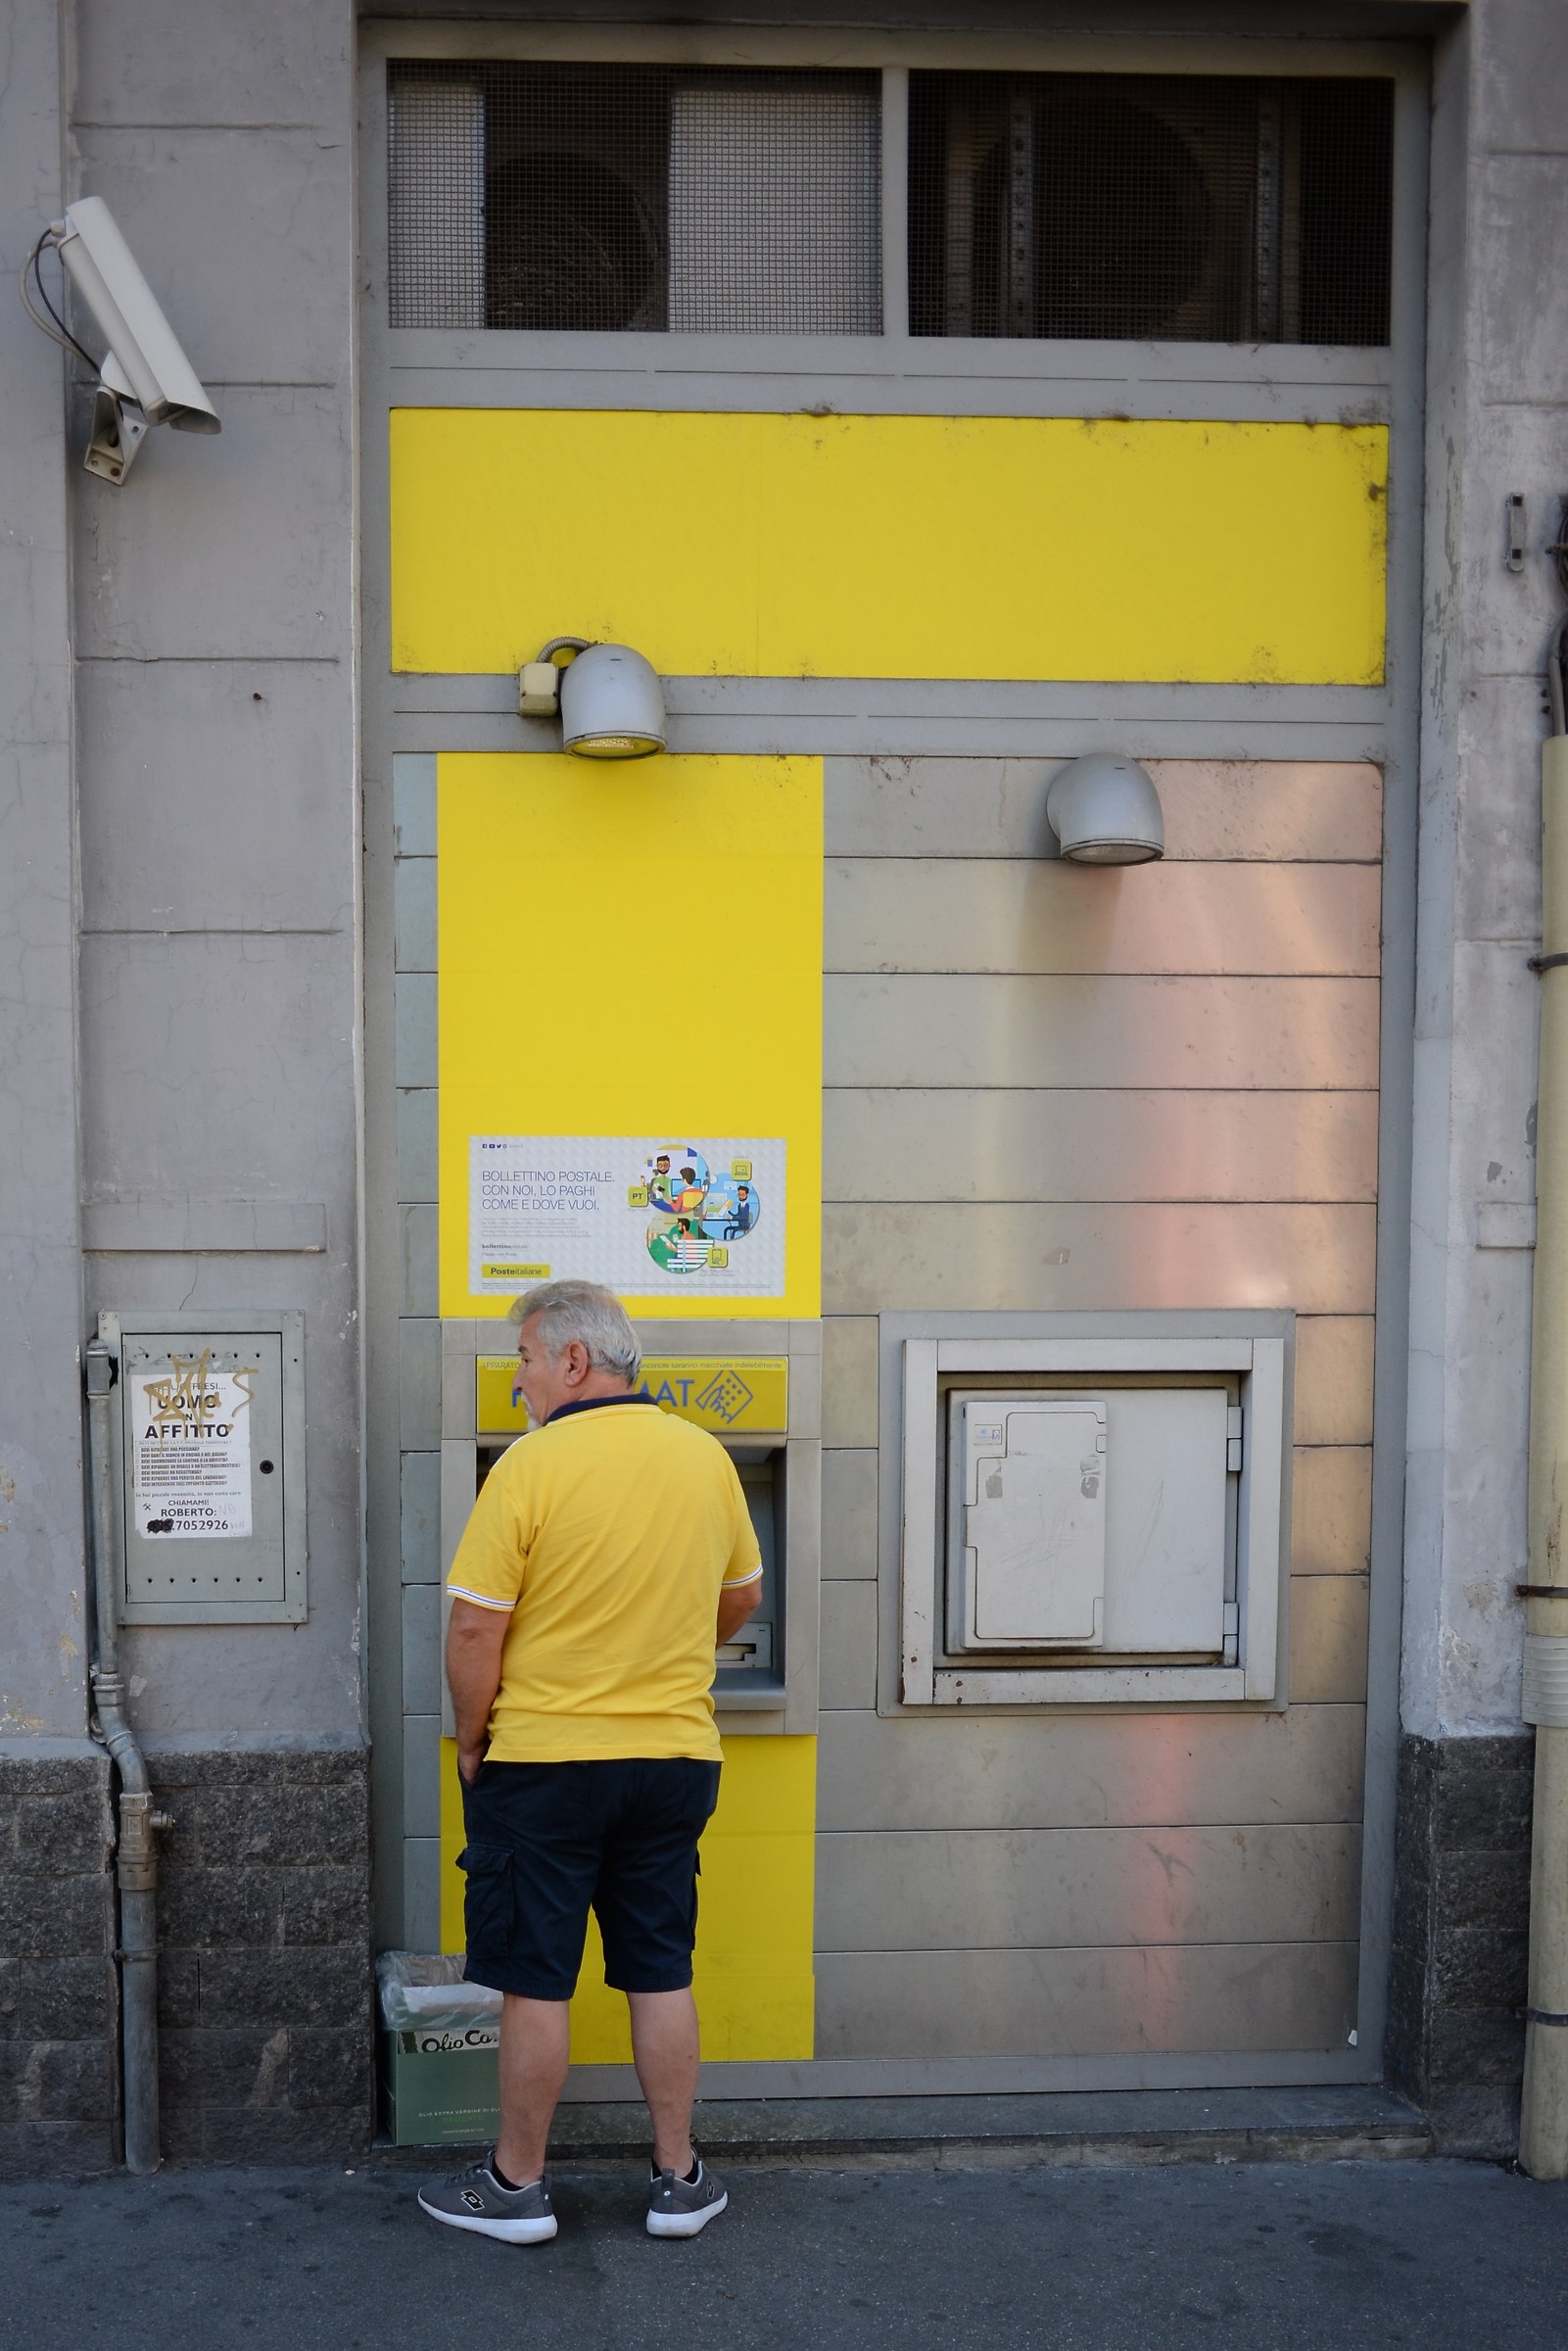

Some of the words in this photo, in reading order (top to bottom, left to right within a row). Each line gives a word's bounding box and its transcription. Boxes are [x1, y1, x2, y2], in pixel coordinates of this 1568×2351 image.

[482, 1171, 555, 1181] BOLLETTINO
[558, 1171, 615, 1182] POSTALE.
[482, 1184, 509, 1196] CON
[512, 1184, 537, 1197] NOI,
[540, 1184, 556, 1196] LO
[559, 1185, 595, 1196] PAGHI
[482, 1199, 518, 1210] COME
[521, 1199, 529, 1210] E
[532, 1199, 565, 1211] DOVE
[567, 1199, 599, 1211] VUOI.
[490, 1267, 542, 1275] Posteitaliane
[144, 1424, 229, 1439] AFFITTO
[161, 1508, 217, 1517] ROBERTO:
[147, 1519, 229, 1532] .7052926
[421, 2033, 464, 2053] Olio
